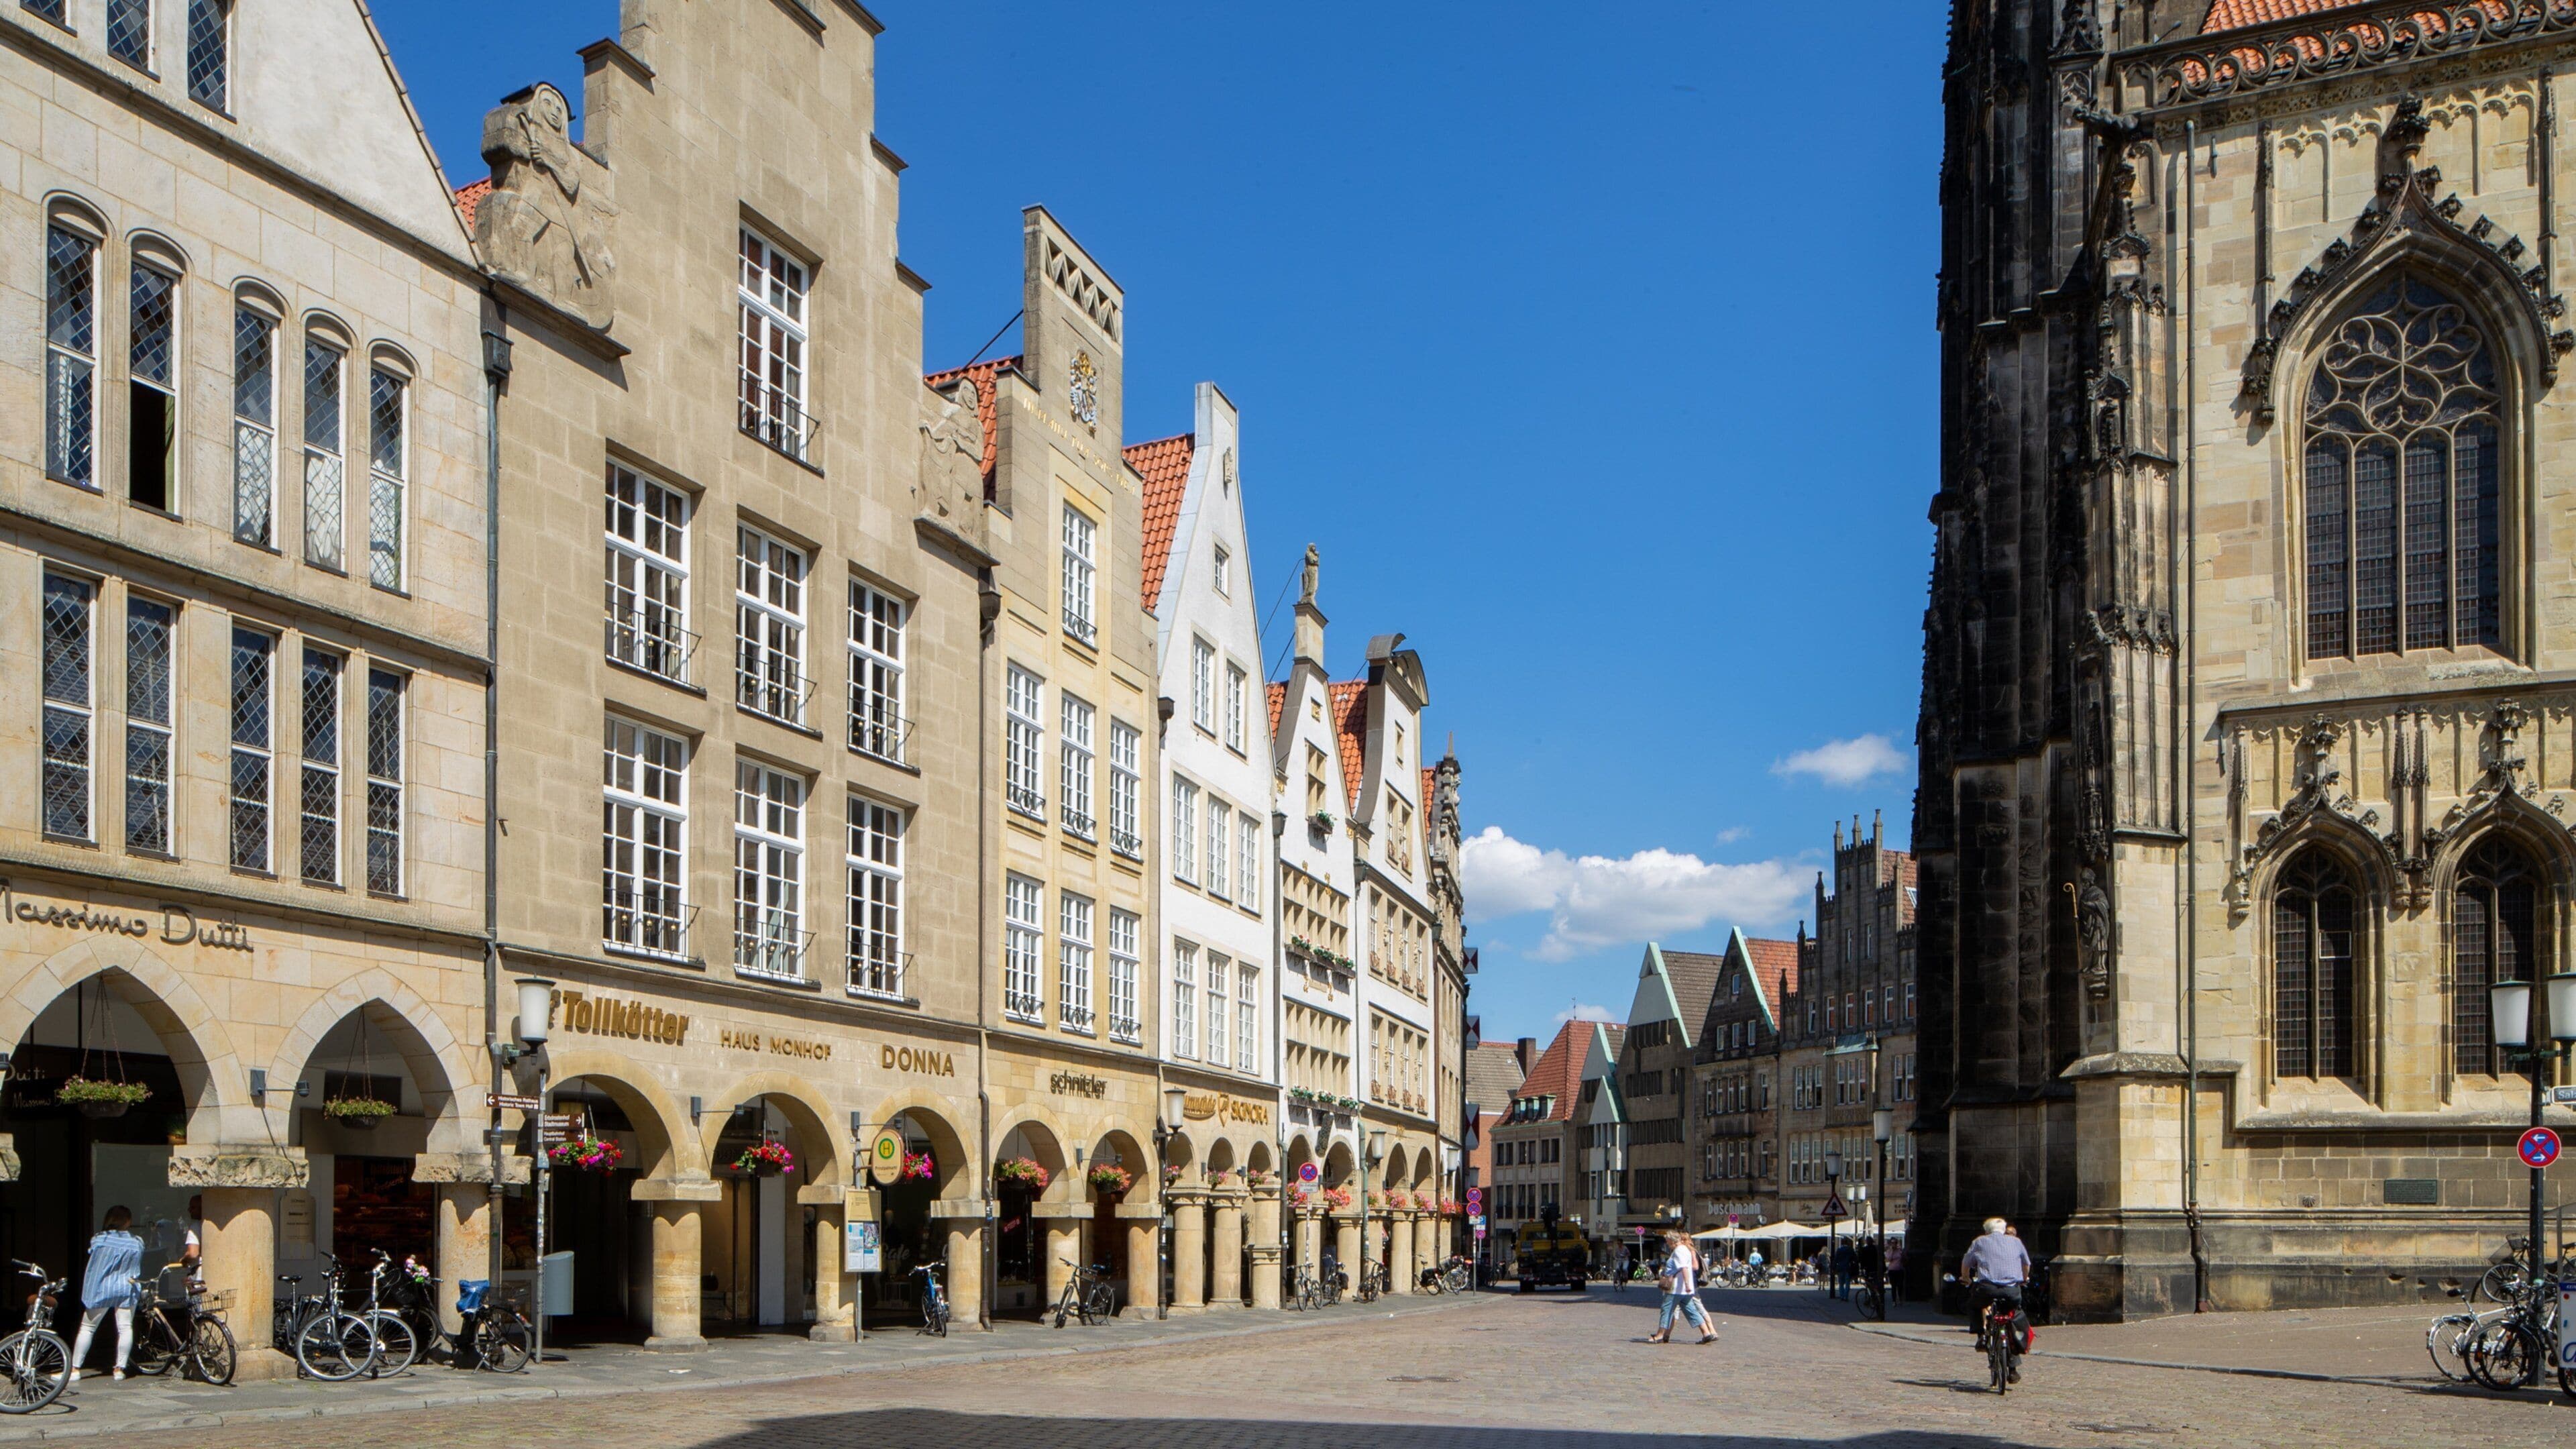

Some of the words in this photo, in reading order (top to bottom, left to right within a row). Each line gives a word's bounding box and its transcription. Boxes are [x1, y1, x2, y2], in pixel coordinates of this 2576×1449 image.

[160, 904, 255, 952] Dutti
[563, 990, 689, 1046] Tollkötter
[720, 1029, 761, 1052] HAUS
[881, 1044, 955, 1077] DONNA
[1051, 1069, 1108, 1100] schnitzler
[1708, 1200, 1761, 1215] buschmann
